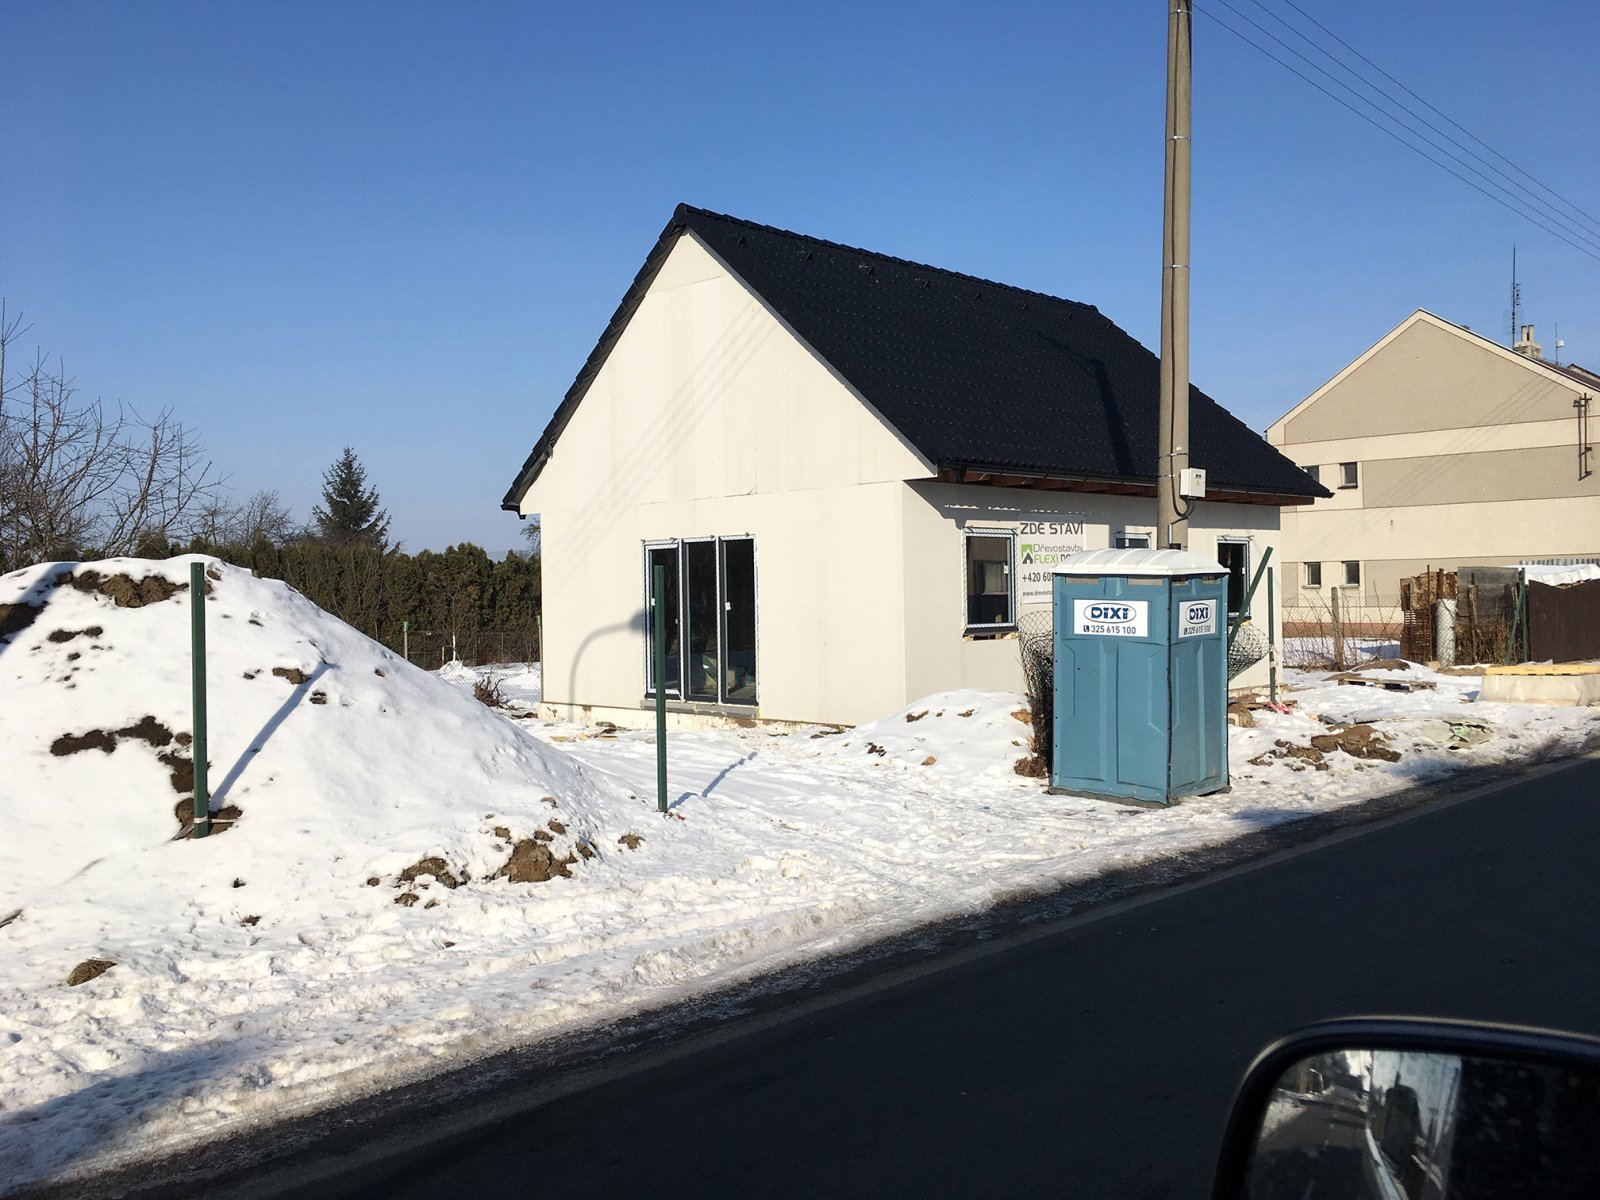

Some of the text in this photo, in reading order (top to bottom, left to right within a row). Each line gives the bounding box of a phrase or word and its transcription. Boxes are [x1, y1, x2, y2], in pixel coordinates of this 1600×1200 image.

[1020, 522, 1045, 535] ZDE
[1033, 543, 1084, 553] Dřevostavby
[1034, 554, 1059, 564] FLEXI
[1022, 572, 1053, 582] +420 60
[1091, 625, 1137, 635] 325 615 100
